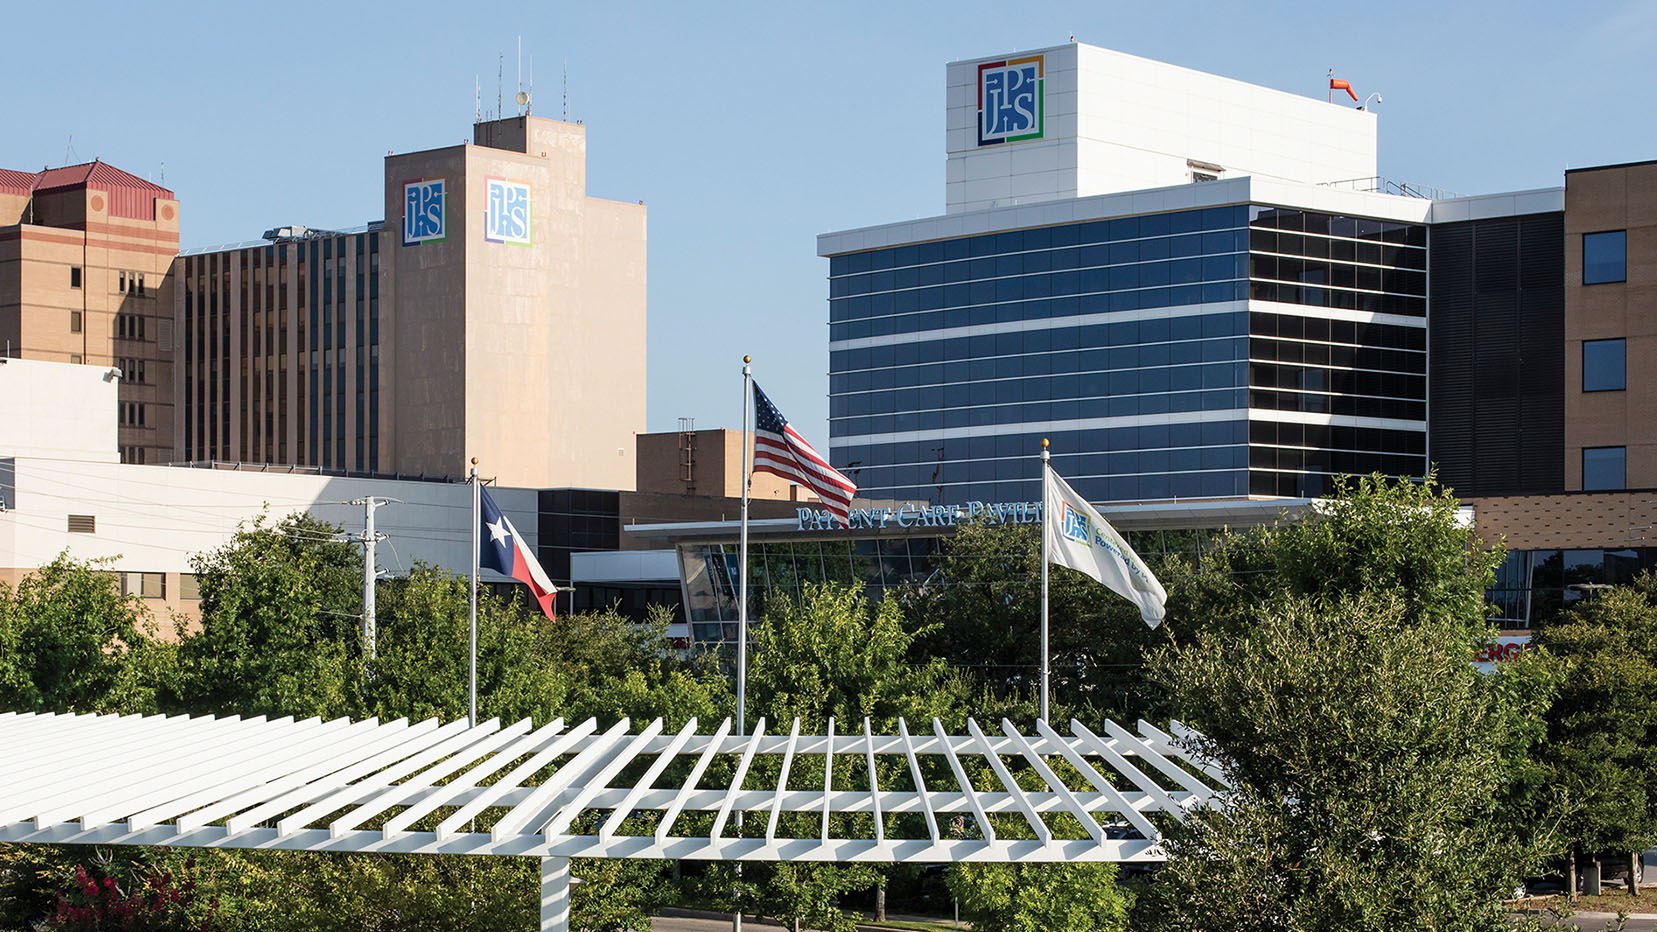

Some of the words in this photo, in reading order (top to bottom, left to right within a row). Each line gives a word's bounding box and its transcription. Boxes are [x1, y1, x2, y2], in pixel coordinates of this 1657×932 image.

[986, 68, 1034, 135] JPS
[408, 184, 441, 239] JPS
[491, 183, 527, 239] JPS
[796, 507, 888, 531] PATENT
[897, 502, 959, 528] CARE
[966, 500, 1042, 525] PAVILI
[1474, 642, 1535, 662] ERG
